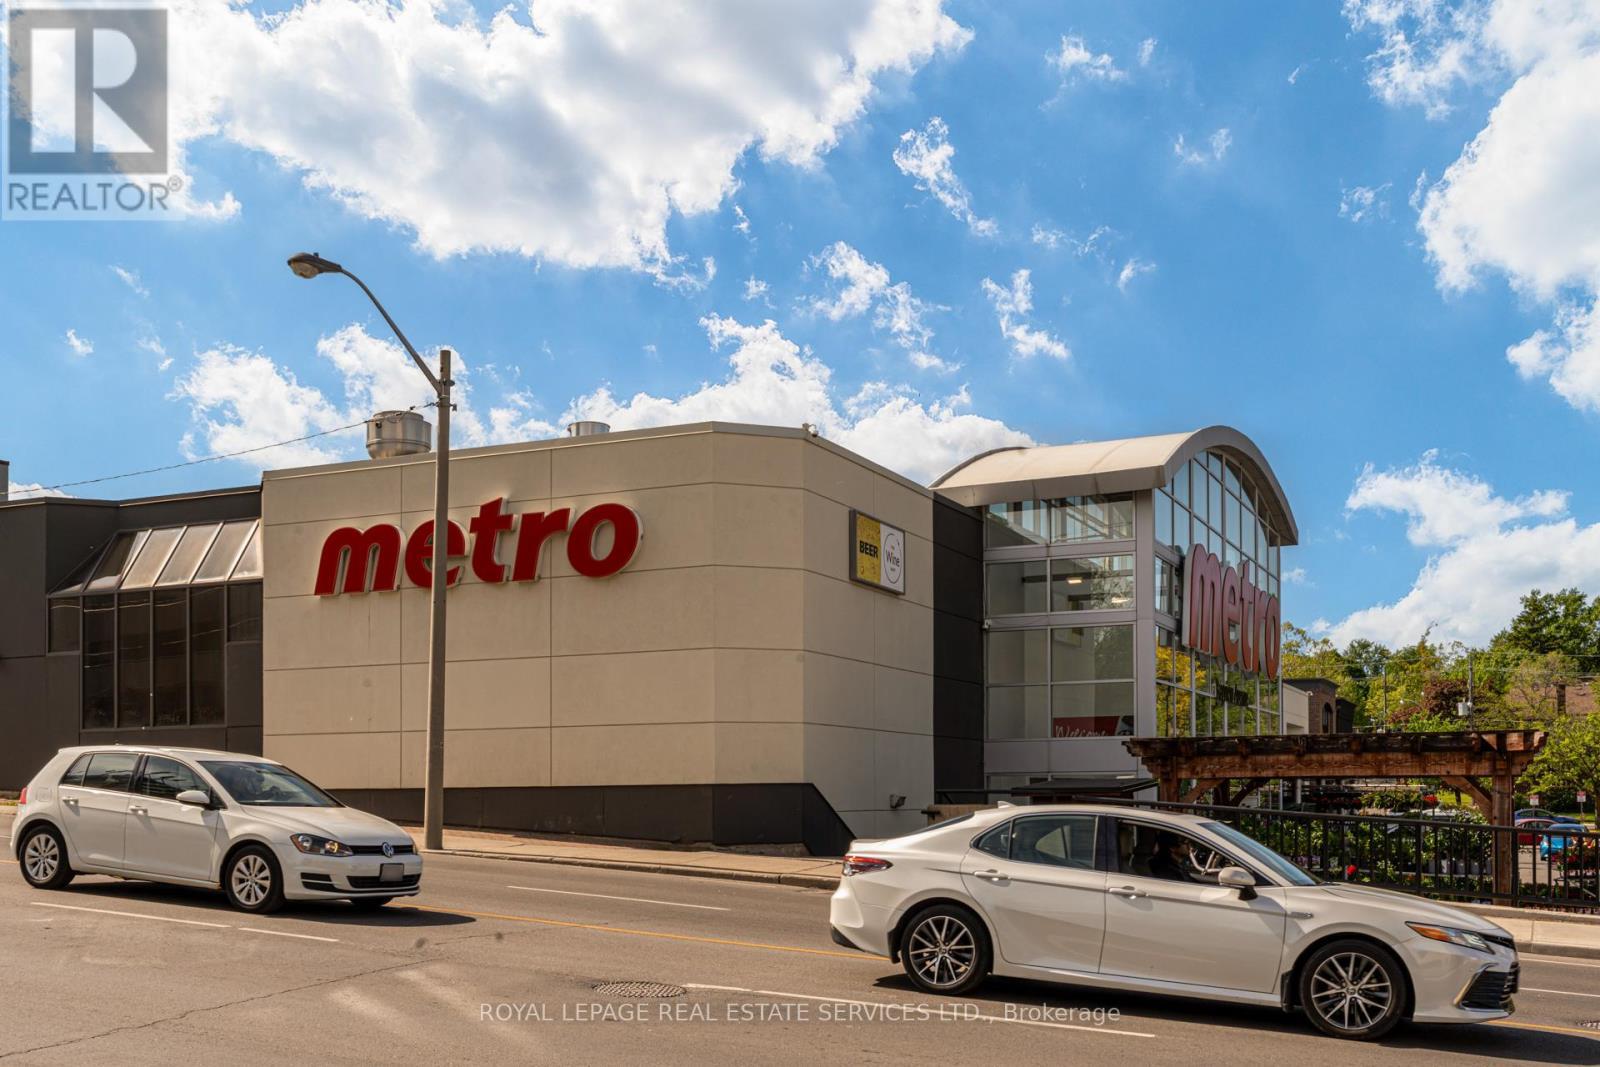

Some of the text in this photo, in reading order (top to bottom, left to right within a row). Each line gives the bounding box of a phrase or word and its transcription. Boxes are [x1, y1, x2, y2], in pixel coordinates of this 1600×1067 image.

[313, 496, 643, 597] metro
[859, 540, 879, 559] BEER
[1182, 543, 1281, 682] metro
